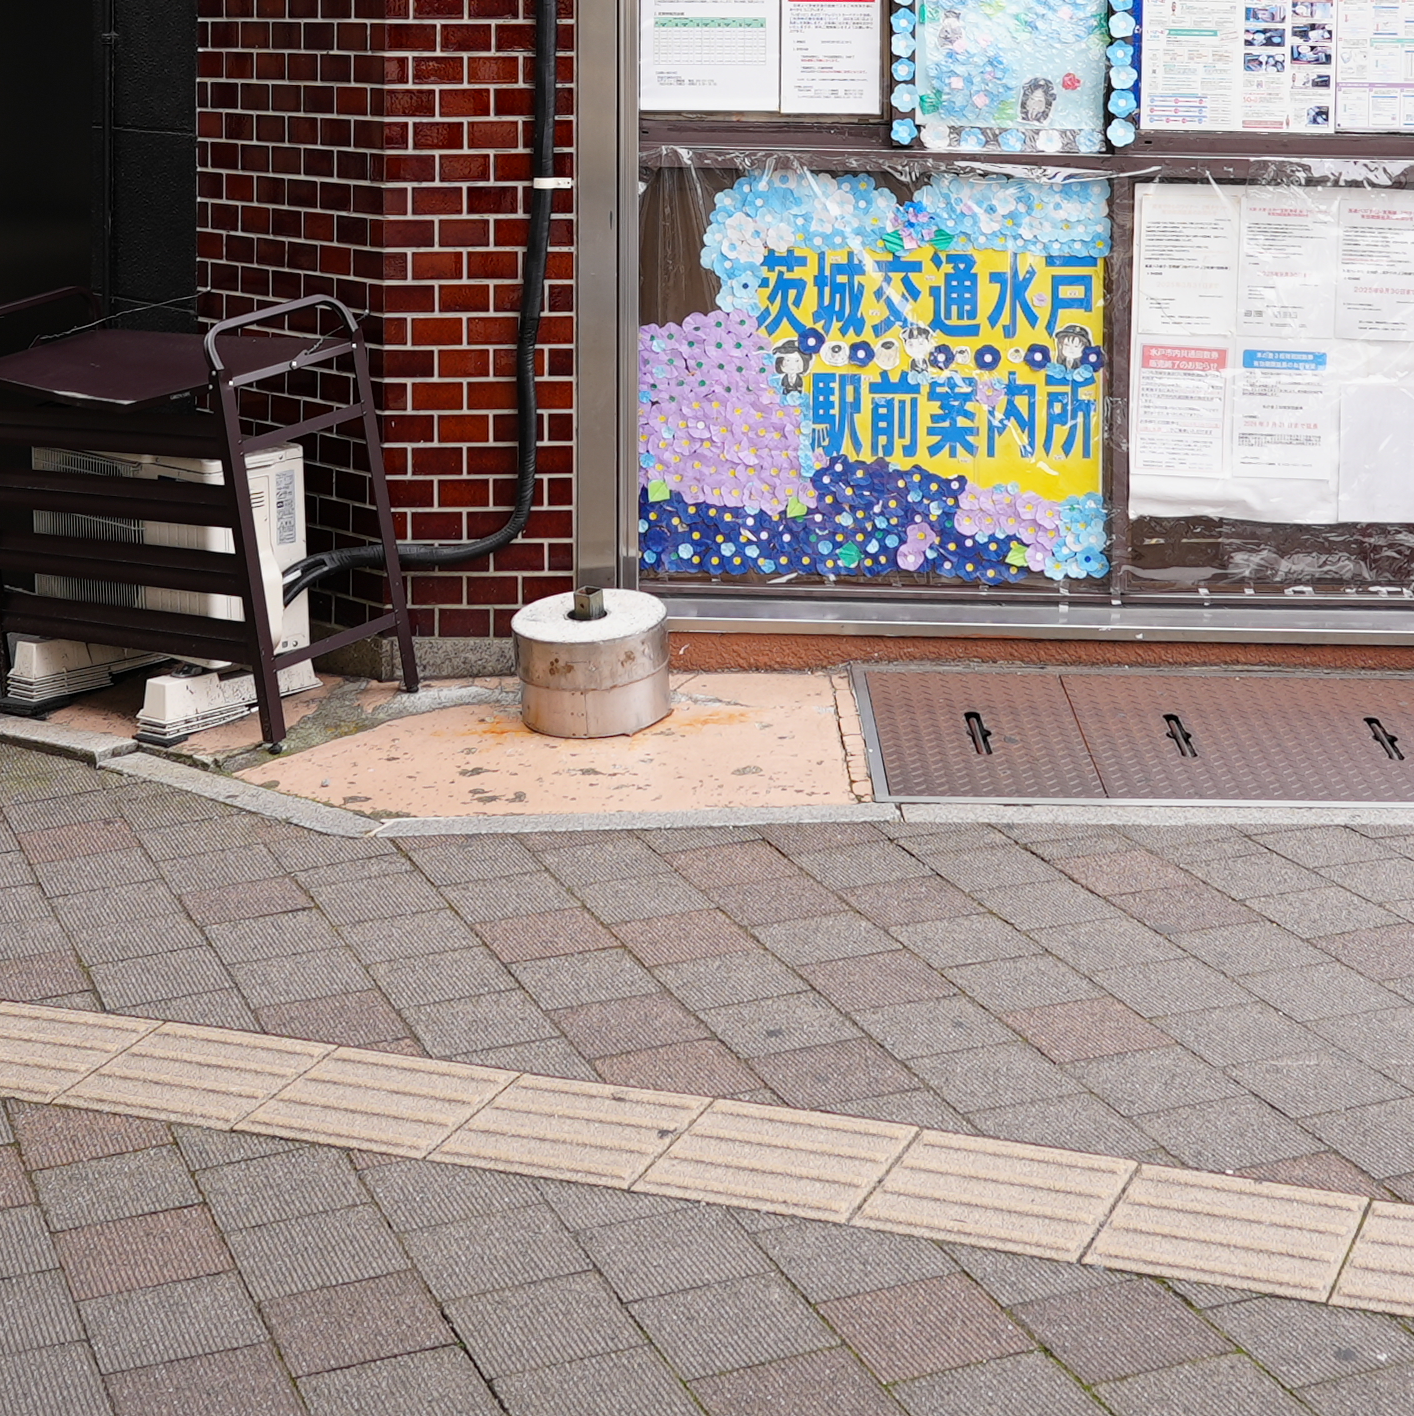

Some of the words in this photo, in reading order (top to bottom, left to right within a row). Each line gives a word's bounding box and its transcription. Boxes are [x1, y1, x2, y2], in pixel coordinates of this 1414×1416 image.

[757, 251, 1099, 339] 茨城交通水戸
[810, 370, 1097, 460] 駅前案内所
